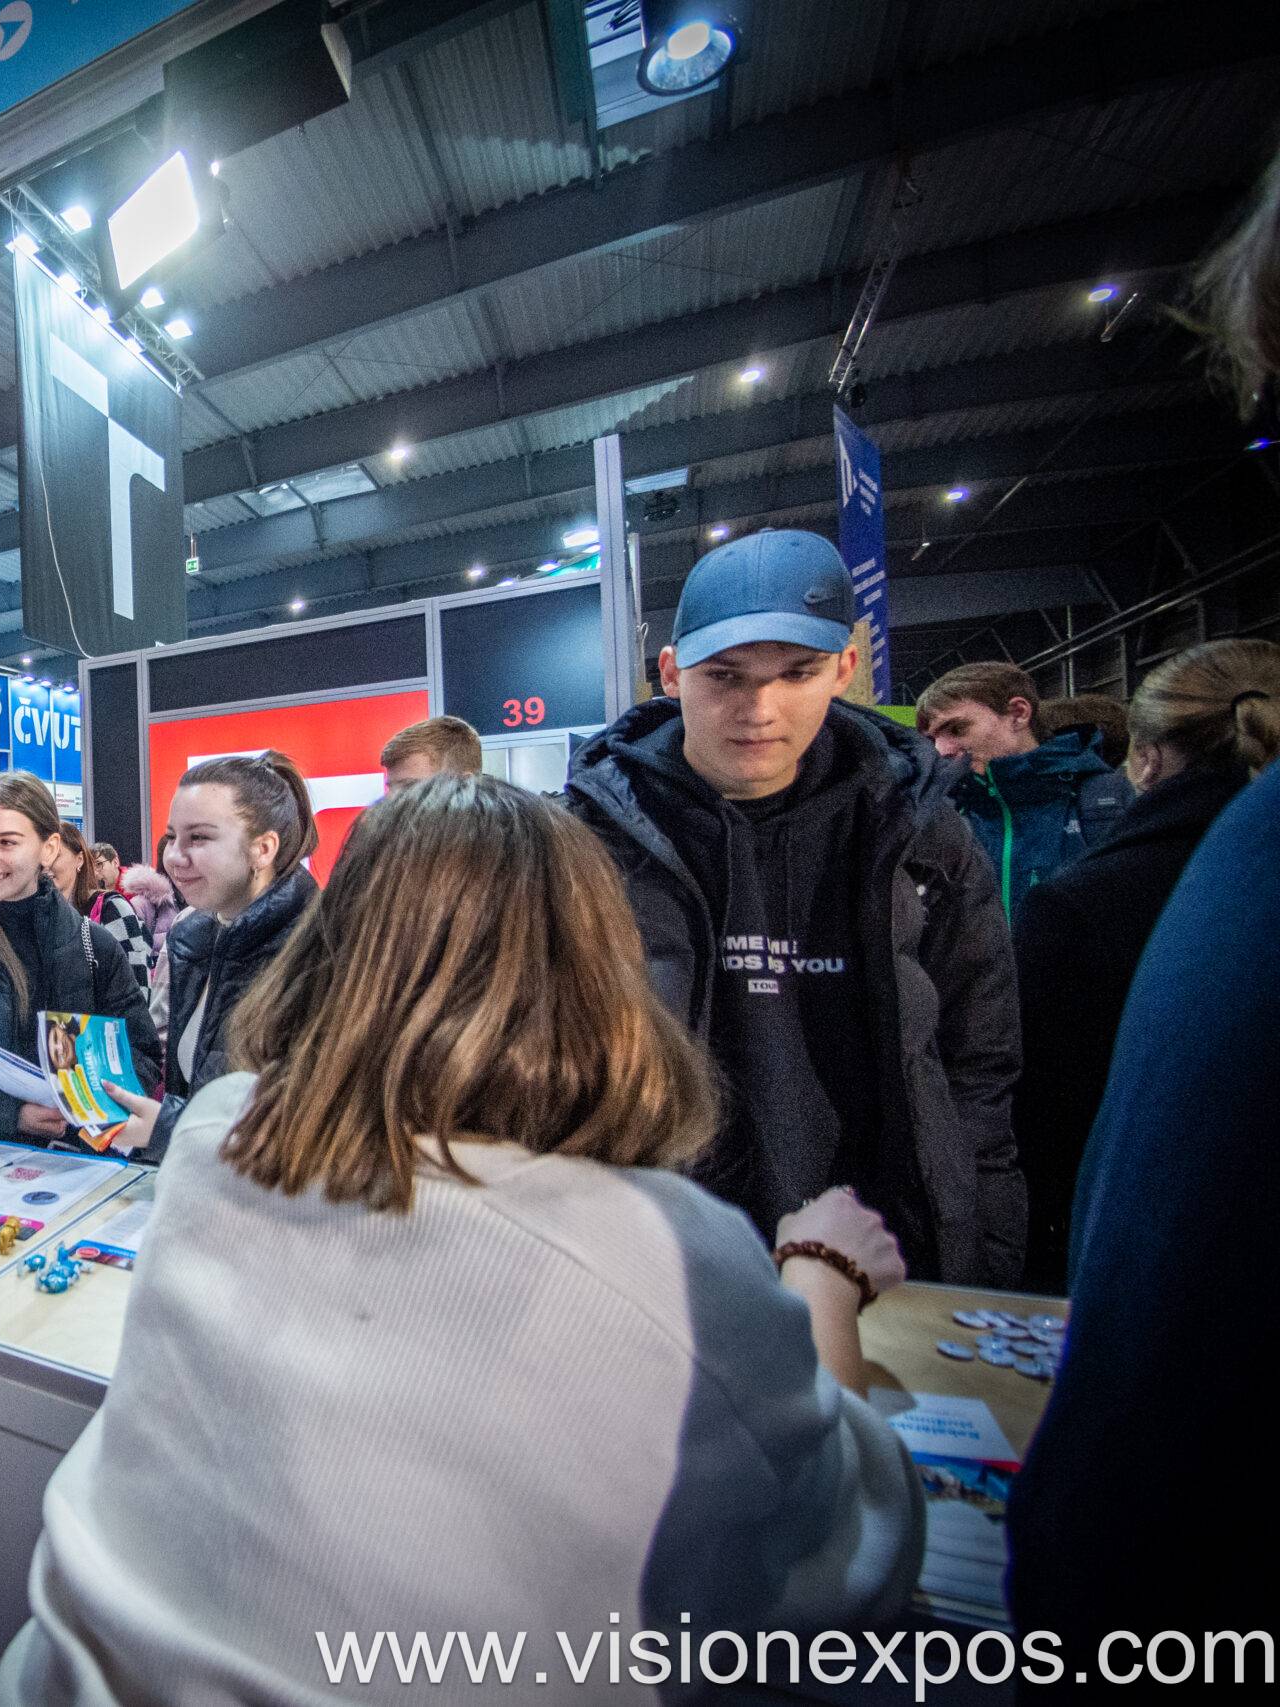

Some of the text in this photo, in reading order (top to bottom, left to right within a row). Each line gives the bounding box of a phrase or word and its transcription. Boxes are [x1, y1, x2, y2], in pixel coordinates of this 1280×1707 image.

[13, 696, 81, 752] ČVUT
[503, 696, 545, 727] 39
[790, 957, 845, 974] YOU
